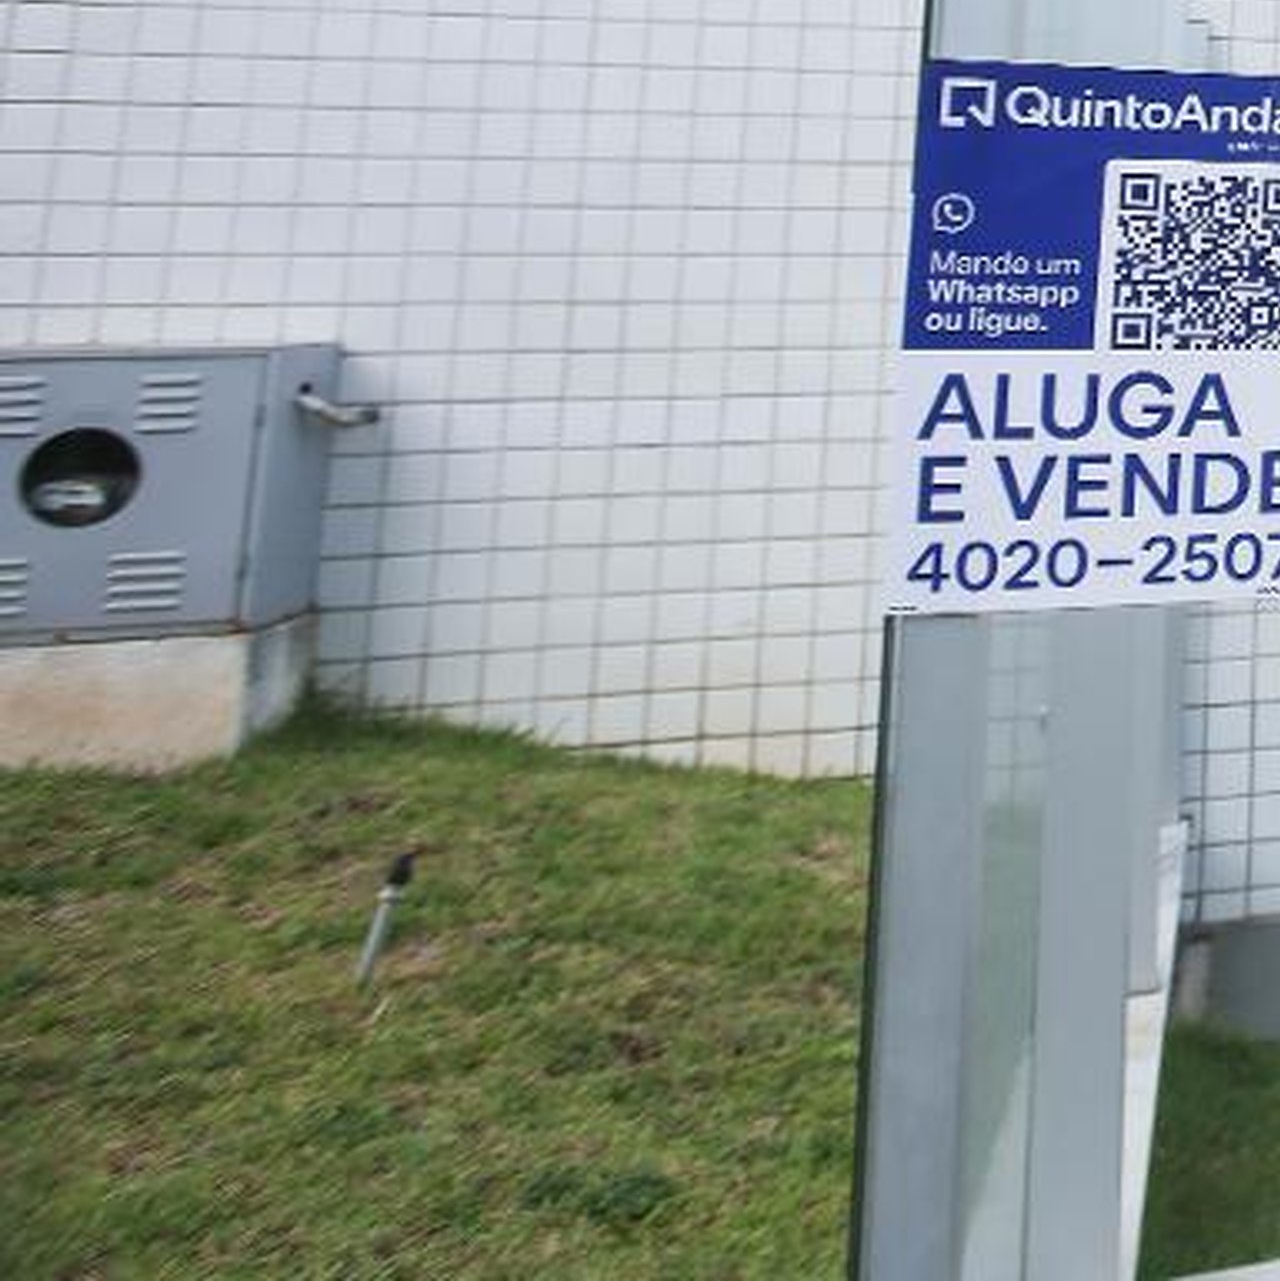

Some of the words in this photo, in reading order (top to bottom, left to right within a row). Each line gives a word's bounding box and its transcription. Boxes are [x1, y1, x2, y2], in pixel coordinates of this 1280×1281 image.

[929, 250, 1030, 275] Mande
[1036, 258, 1082, 275] um
[927, 279, 1081, 308] Whatsapp
[924, 311, 963, 332] ou
[968, 306, 1050, 337] ligue.
[916, 370, 1242, 441] ALUGA
[916, 455, 968, 523] E
